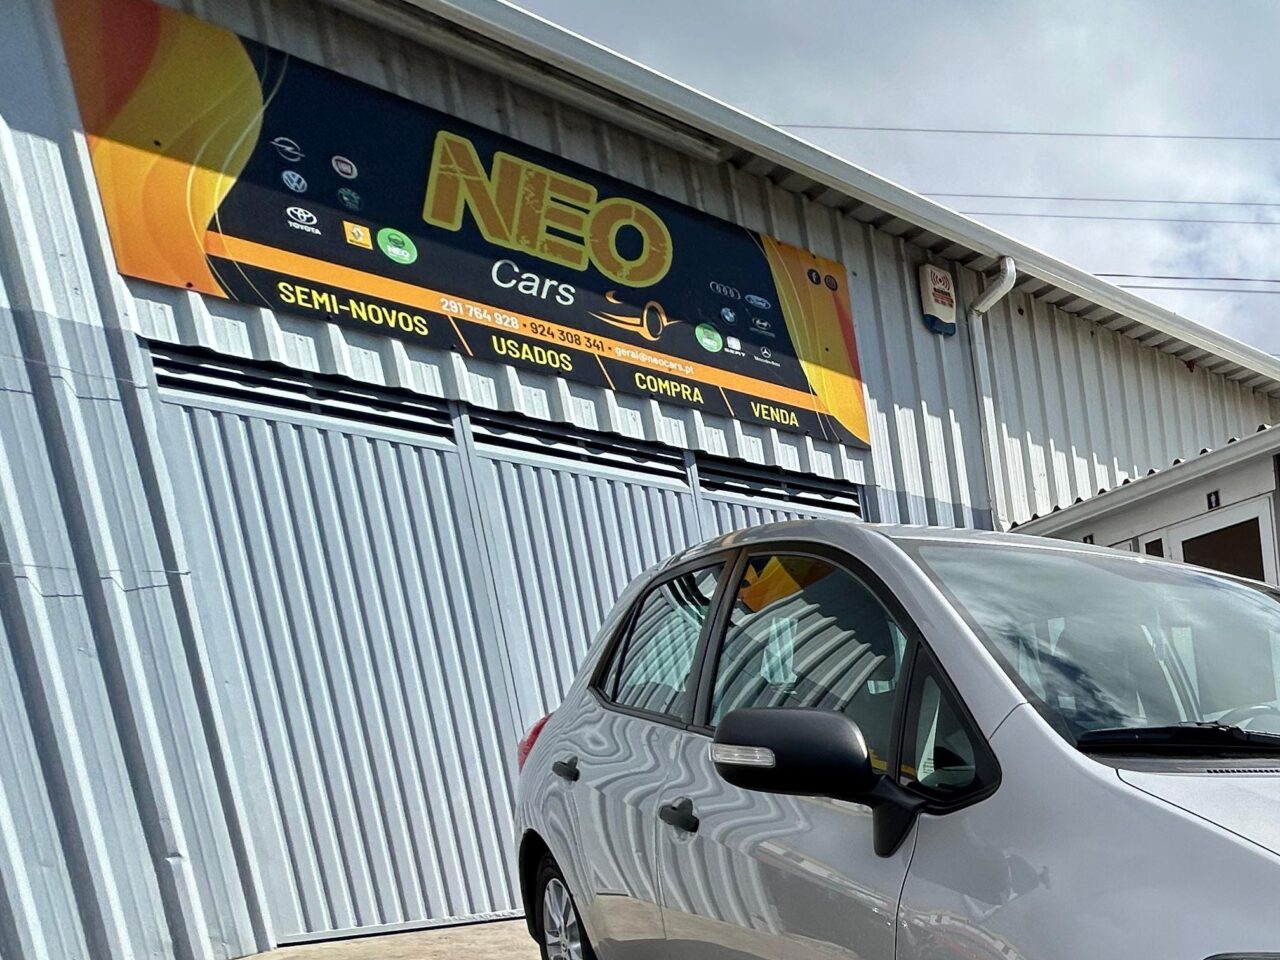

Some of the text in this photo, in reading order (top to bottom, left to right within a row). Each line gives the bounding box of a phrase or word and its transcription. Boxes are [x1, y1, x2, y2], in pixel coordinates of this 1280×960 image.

[287, 219, 322, 236] TOYOTA
[422, 130, 673, 288] NEO
[491, 259, 576, 306] Cars
[277, 281, 429, 336] SEMI-NOVOS
[441, 297, 695, 375] 291 764 928 924 308 341 geral@neocars.pt
[491, 335, 573, 372] USADOS
[634, 372, 705, 404] COMPRA
[750, 401, 800, 427] VENDA
